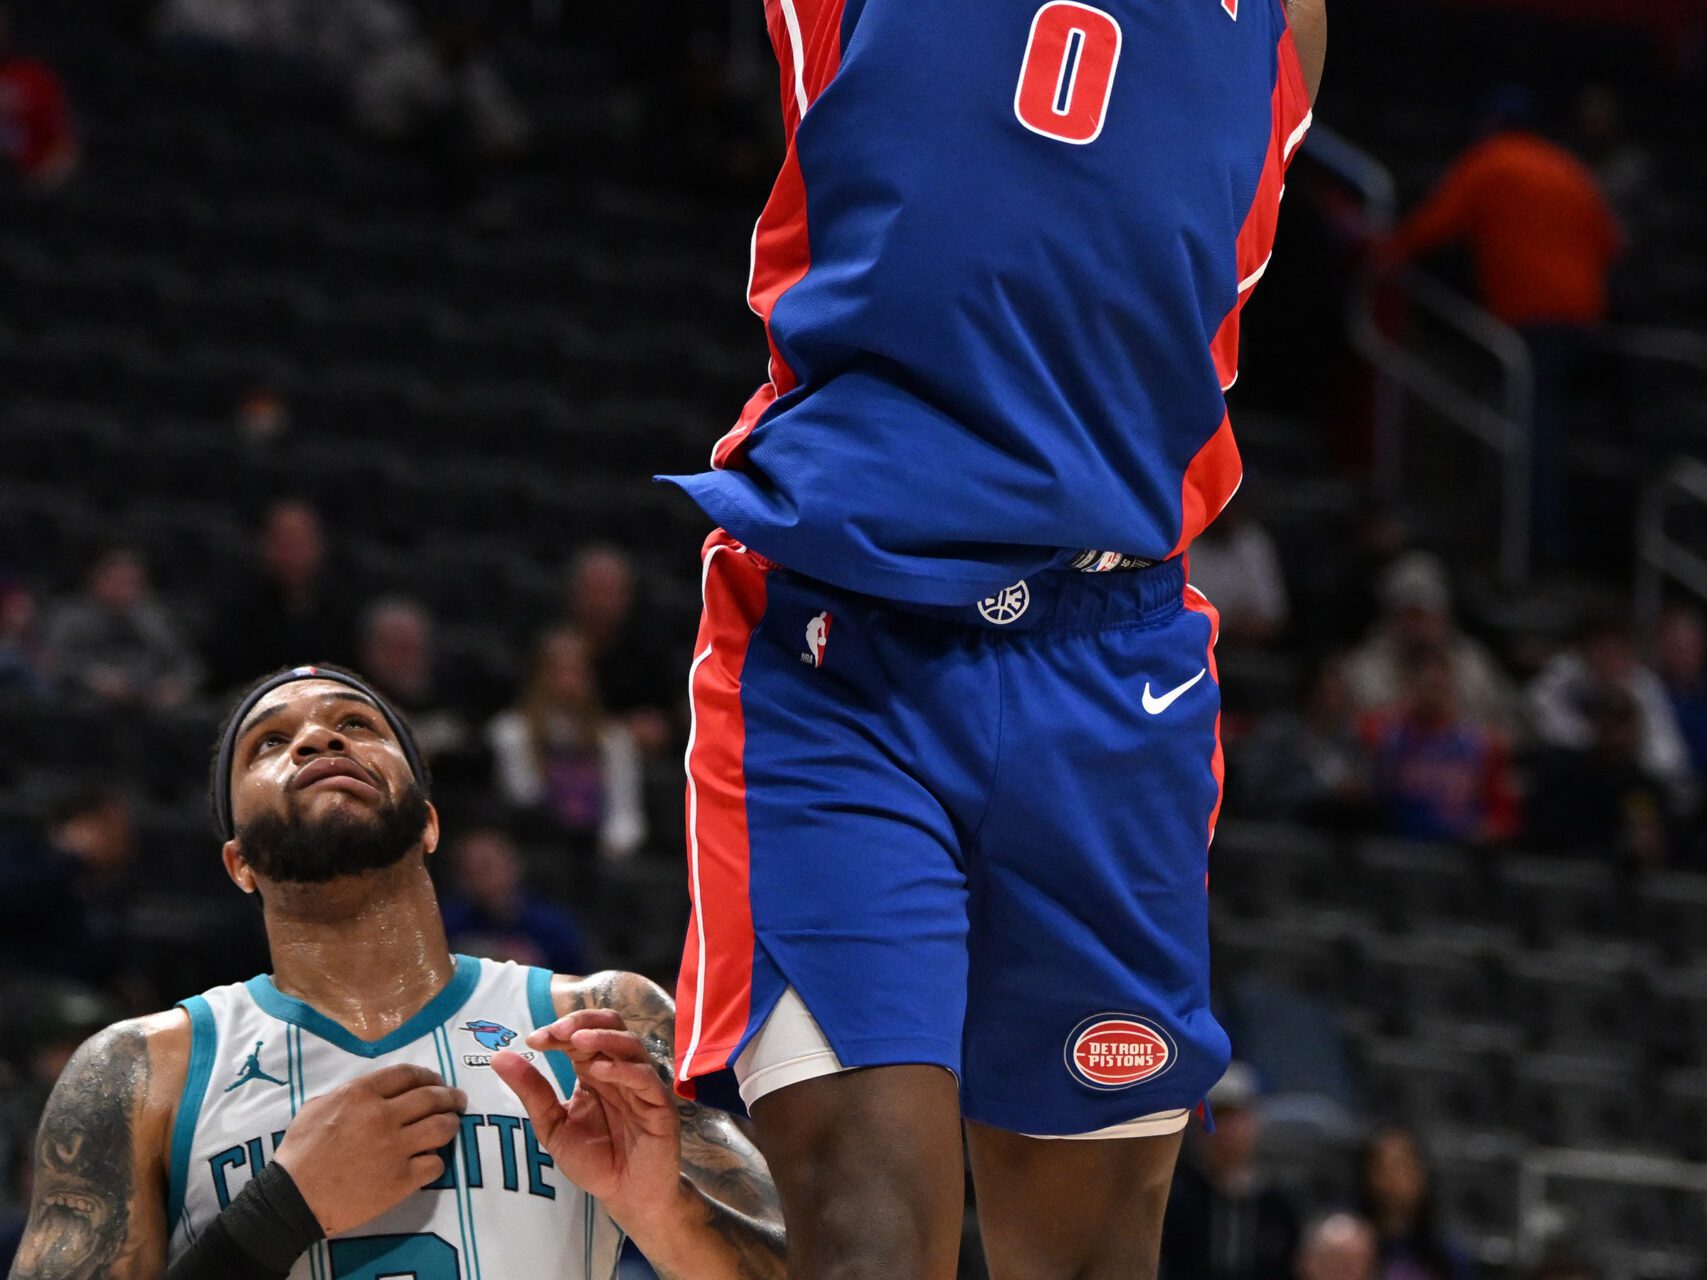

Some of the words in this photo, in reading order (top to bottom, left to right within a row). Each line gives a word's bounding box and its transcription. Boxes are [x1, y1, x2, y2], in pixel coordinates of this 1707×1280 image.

[1014, 0, 1122, 144] 0
[1088, 1041, 1153, 1055] DETROIT
[1088, 1055, 1154, 1067] PISTONS
